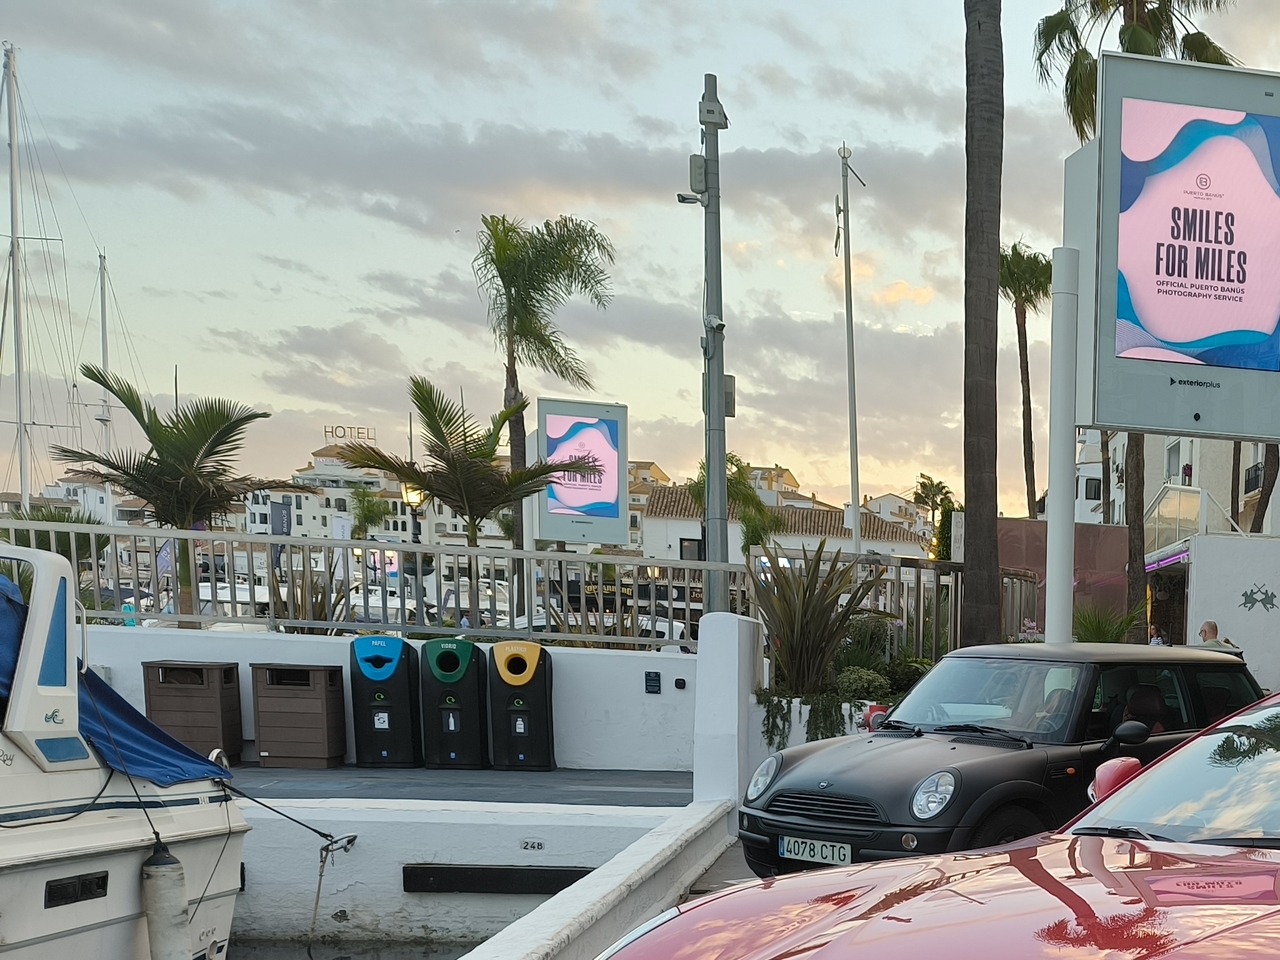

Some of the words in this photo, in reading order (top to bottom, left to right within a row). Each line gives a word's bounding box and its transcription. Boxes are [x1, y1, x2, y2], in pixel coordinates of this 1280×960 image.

[1171, 206, 1235, 246] SMILES
[1155, 242, 1189, 279] FOR
[1195, 246, 1247, 284] MILES
[1156, 280, 1189, 290] OFFICIAL
[1190, 283, 1219, 292] PUERTO
[1157, 288, 1212, 300] PHOTOGRAPHY
[1213, 294, 1244, 303] SERVICE
[1178, 379, 1221, 389] exteriorplus
[324, 425, 376, 440] HOTEL
[523, 841, 544, 851] 248
[786, 839, 816, 858] 4078
[820, 844, 847, 862] CTG
